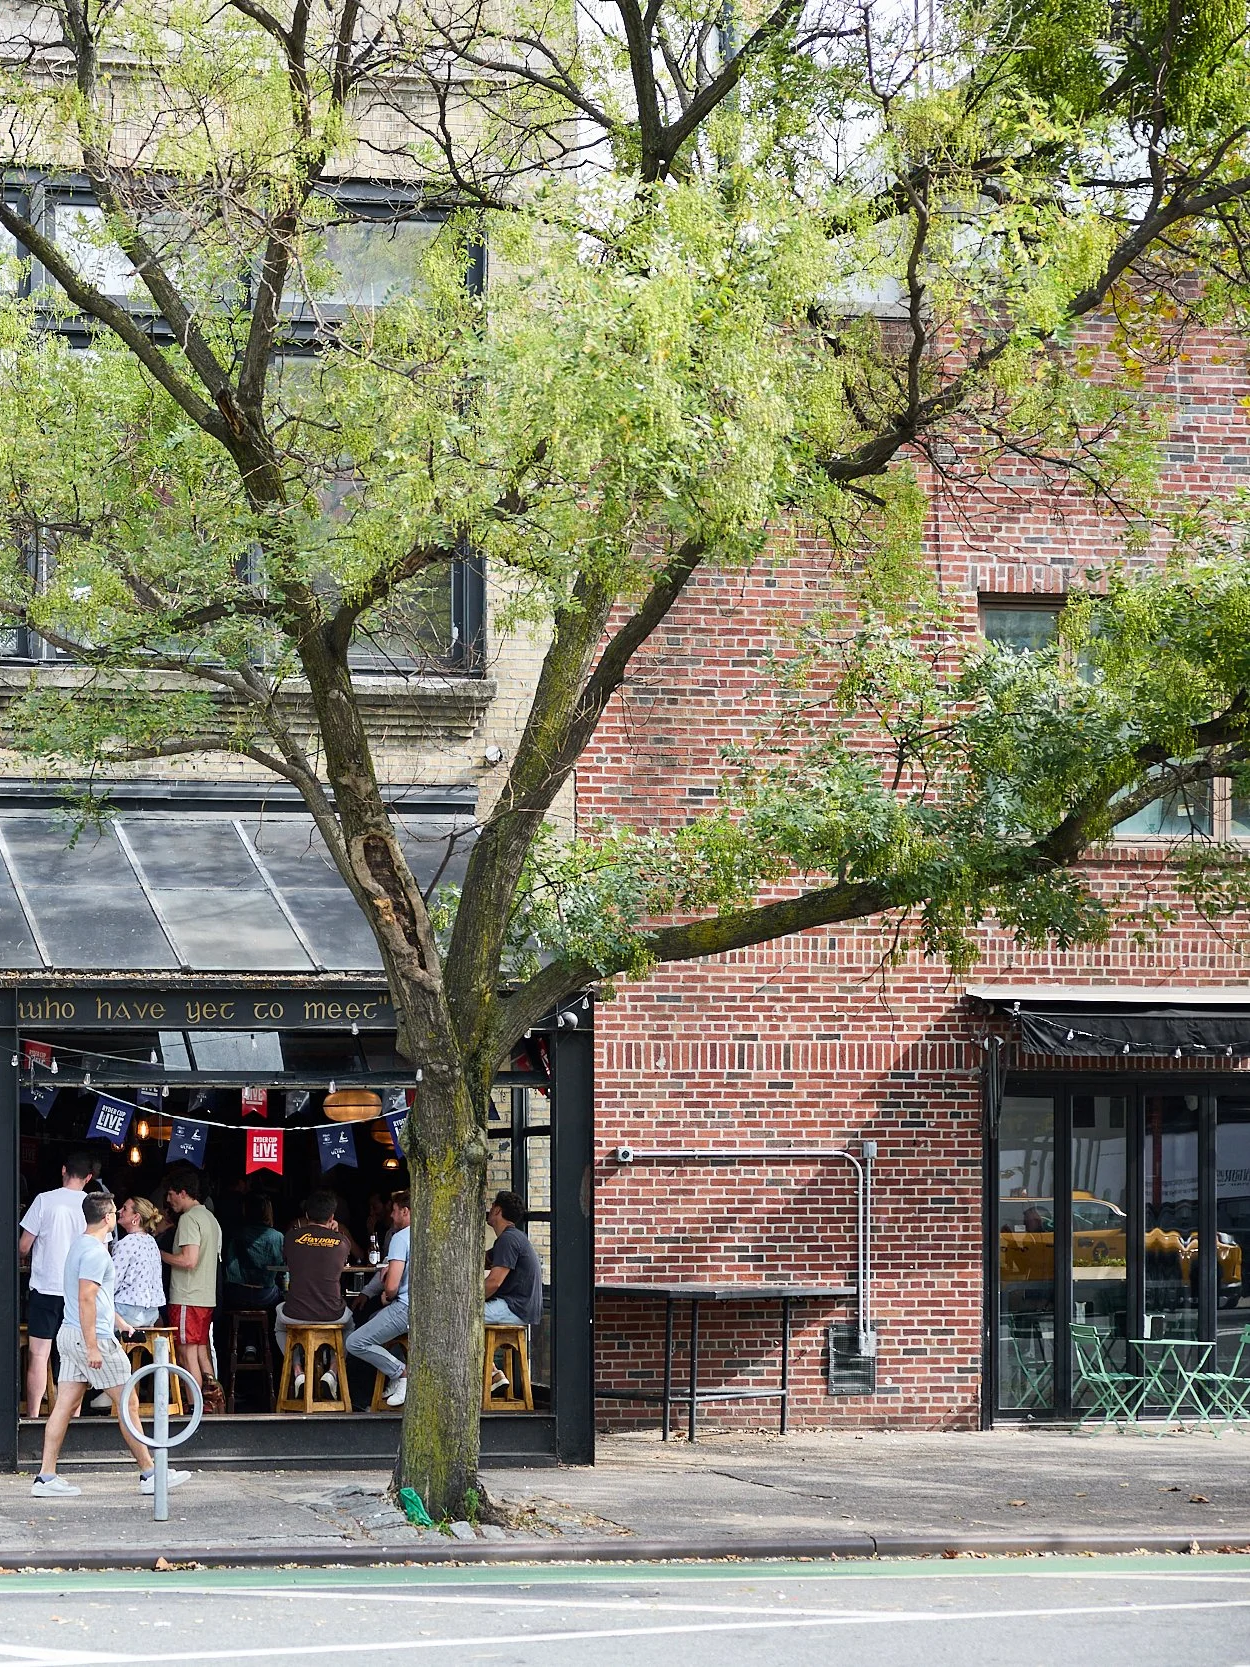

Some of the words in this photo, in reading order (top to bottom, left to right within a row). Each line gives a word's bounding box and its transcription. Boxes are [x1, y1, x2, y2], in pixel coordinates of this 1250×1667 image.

[101, 1104, 117, 1115] RYDER
[117, 1109, 127, 1118] CUP
[96, 1111, 125, 1132] LIVE
[253, 1143, 278, 1158] LIVE
